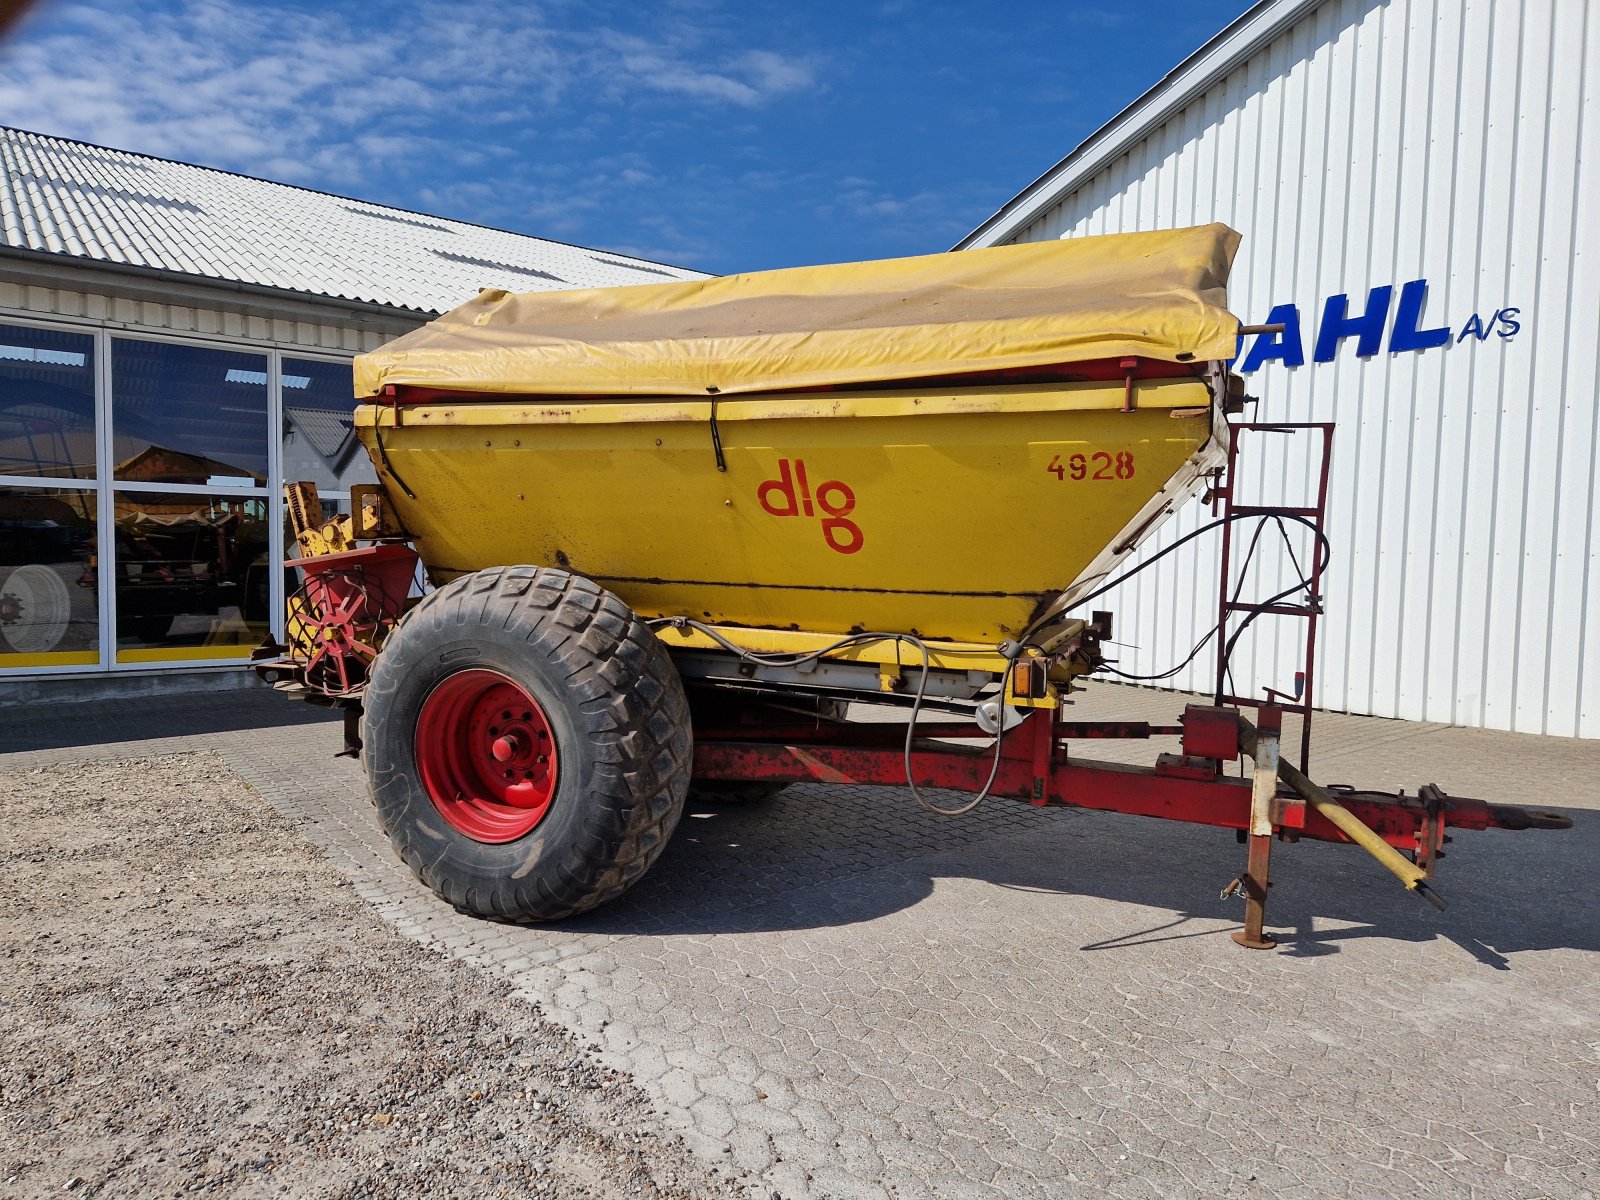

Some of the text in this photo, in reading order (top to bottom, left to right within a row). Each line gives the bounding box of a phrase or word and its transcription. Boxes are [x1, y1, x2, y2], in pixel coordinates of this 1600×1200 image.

[1457, 307, 1521, 344] A/S
[1047, 451, 1136, 481] 4928
[757, 458, 864, 555] dlg
